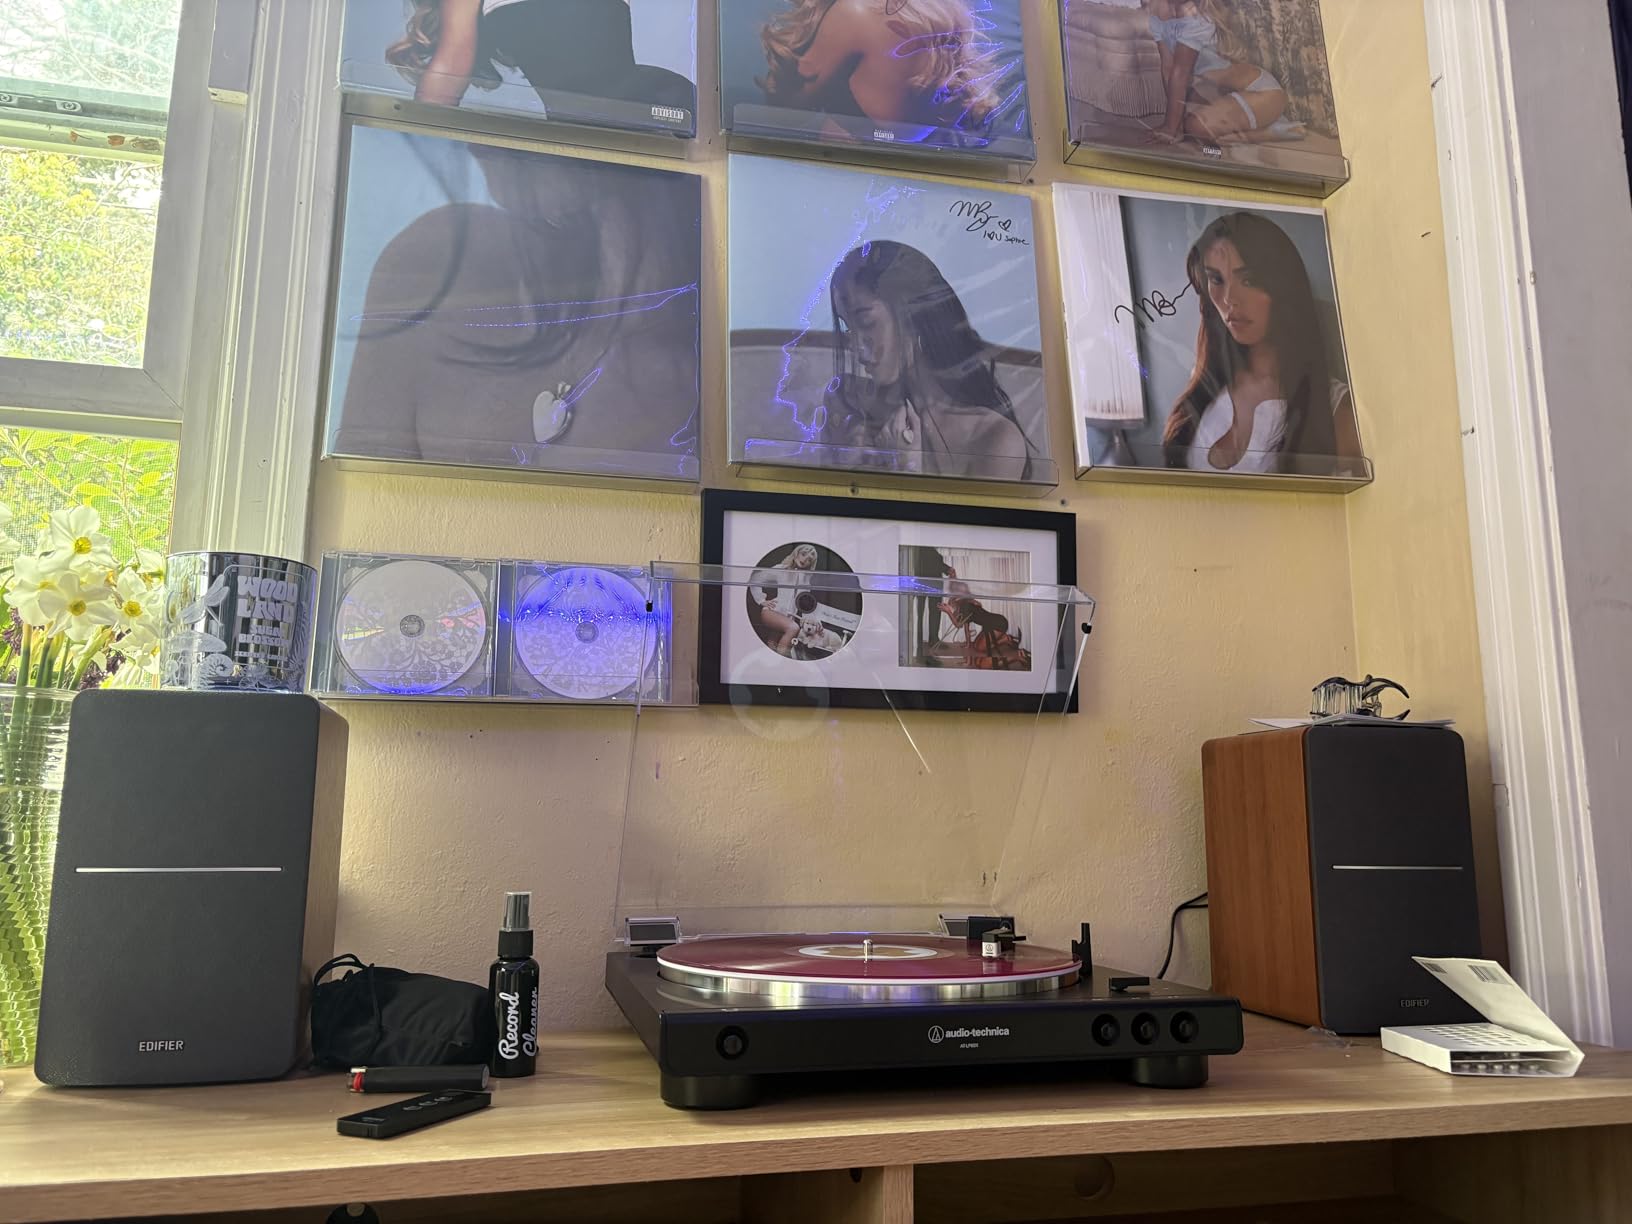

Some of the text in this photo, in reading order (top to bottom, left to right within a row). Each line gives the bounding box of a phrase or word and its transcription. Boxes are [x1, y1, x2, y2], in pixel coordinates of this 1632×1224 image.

[237, 575, 298, 603] WOOD
[236, 598, 295, 624] LAND
[1400, 998, 1430, 1008] EDIFIER
[498, 986, 538, 1060] Record Cleaner
[945, 1026, 1010, 1038] audio-technica
[138, 1040, 184, 1052] EDIFIER
